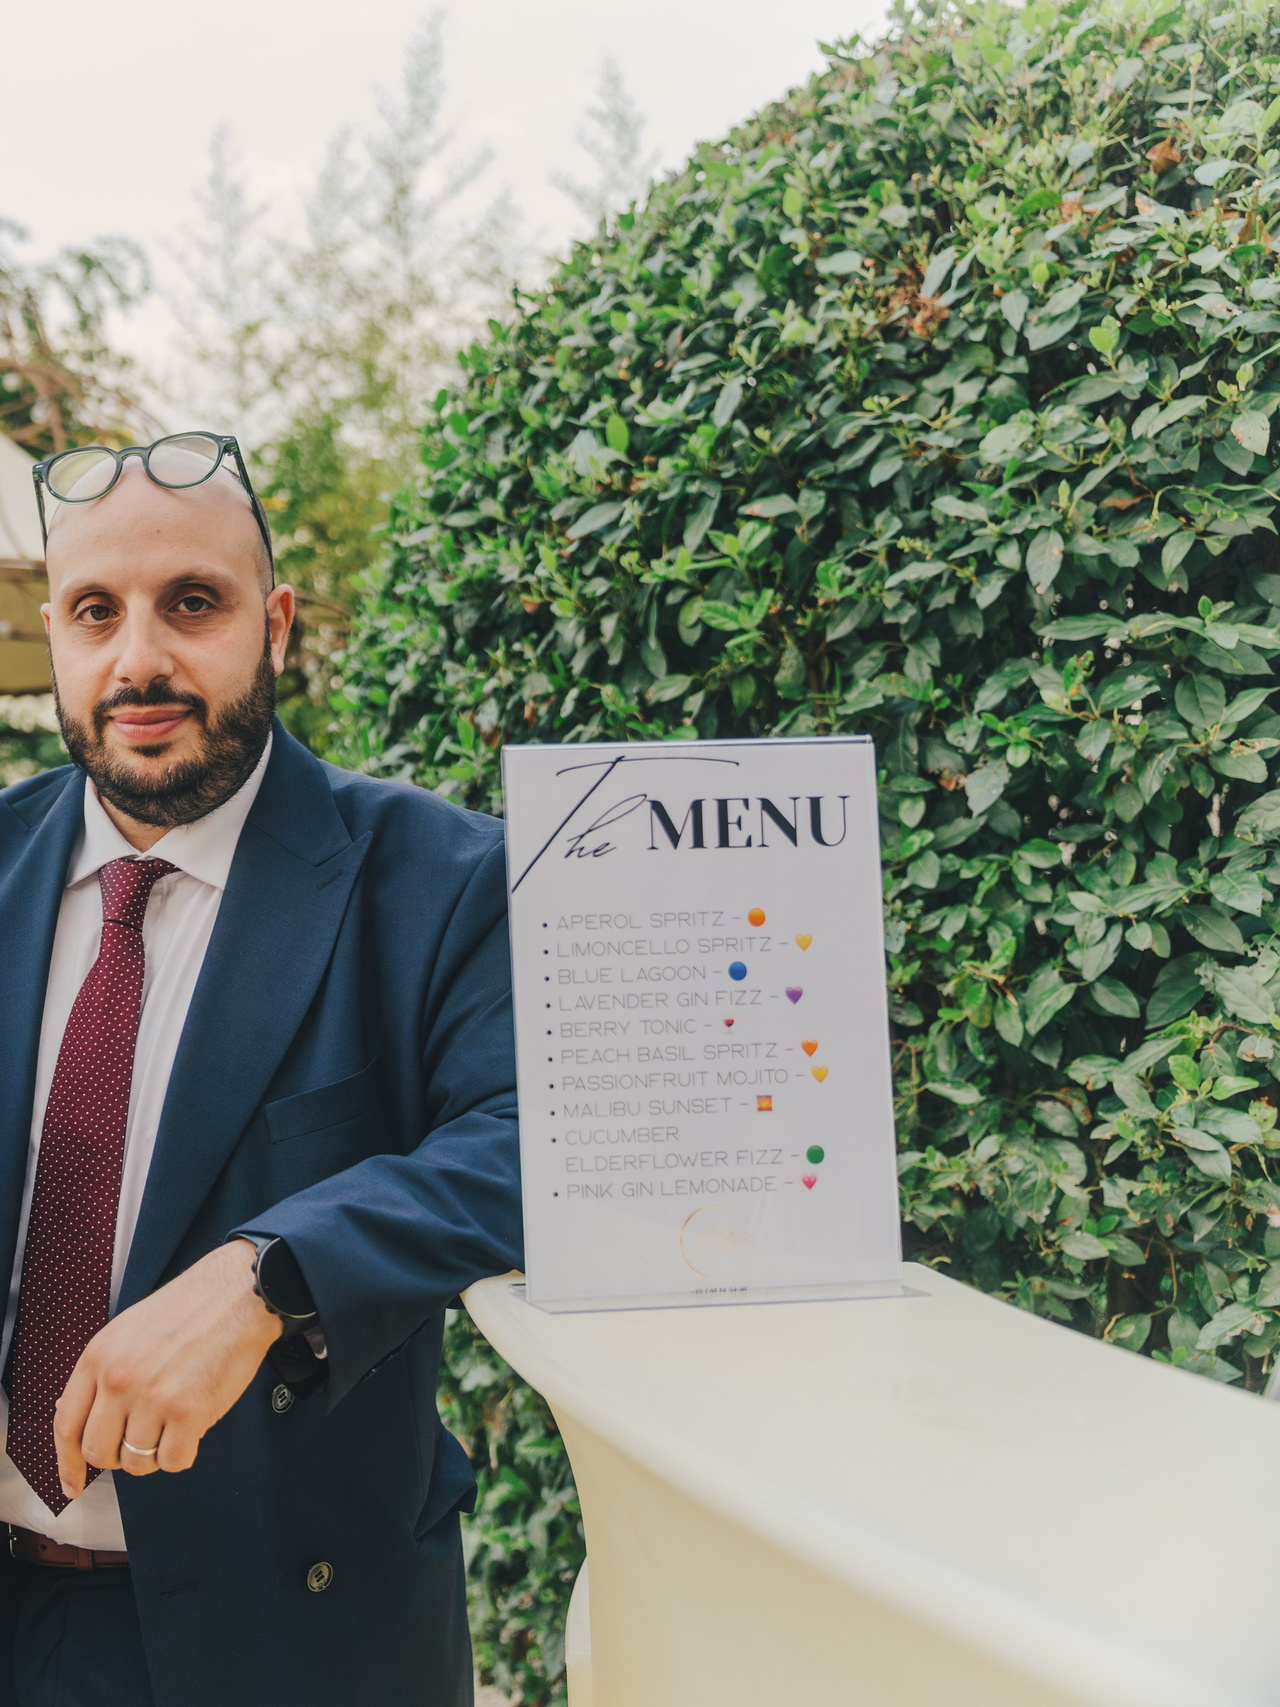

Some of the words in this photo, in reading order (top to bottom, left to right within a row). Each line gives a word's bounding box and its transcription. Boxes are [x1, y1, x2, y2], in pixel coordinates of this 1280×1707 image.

[512, 755, 739, 894] The
[646, 795, 850, 851] MENU
[557, 914, 641, 930] APEROL
[650, 911, 724, 928] SPRITZ
[557, 939, 689, 957] LIMONCELLO
[698, 936, 771, 953] SPRITZ
[558, 968, 612, 984] BLUE
[621, 965, 706, 982] LAGOON
[559, 992, 668, 1011] LAVENDER
[677, 992, 708, 1007] GIN
[715, 989, 762, 1005] FIZZ
[560, 1021, 630, 1038] BERRY
[640, 1019, 696, 1035] TONIC
[561, 1048, 630, 1064] PEACH
[637, 1046, 695, 1062] BASIL
[703, 1042, 777, 1060] SPRITZ
[563, 1071, 708, 1091] PASSIONFRUIT
[717, 1069, 788, 1086] MOJITO
[564, 1101, 640, 1118] MALIBU
[649, 1097, 732, 1115] SUNSET
[565, 1126, 679, 1145] CUCUMBER
[566, 1151, 728, 1172] ELDERFLOWER
[737, 1149, 783, 1165] FIZZ
[567, 1183, 613, 1199] PINK
[622, 1182, 653, 1197] GIN
[661, 1176, 777, 1196] LEMONADE
